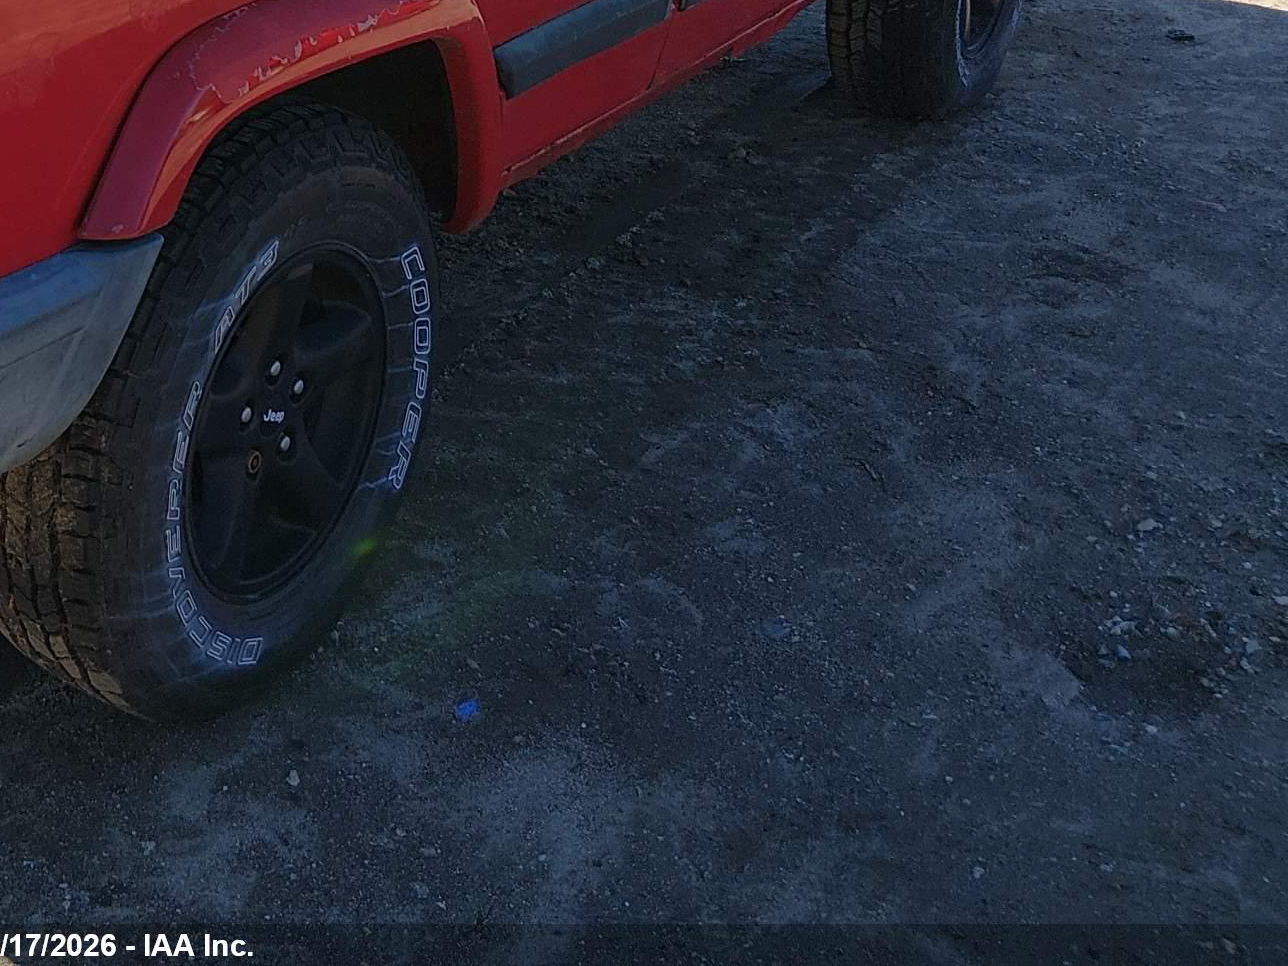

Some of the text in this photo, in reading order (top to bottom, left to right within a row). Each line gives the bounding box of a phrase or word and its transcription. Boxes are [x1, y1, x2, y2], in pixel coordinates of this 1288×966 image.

[263, 408, 285, 424] Jeep
[388, 245, 432, 490] COOPER
[164, 379, 264, 666] DISCOVERER
